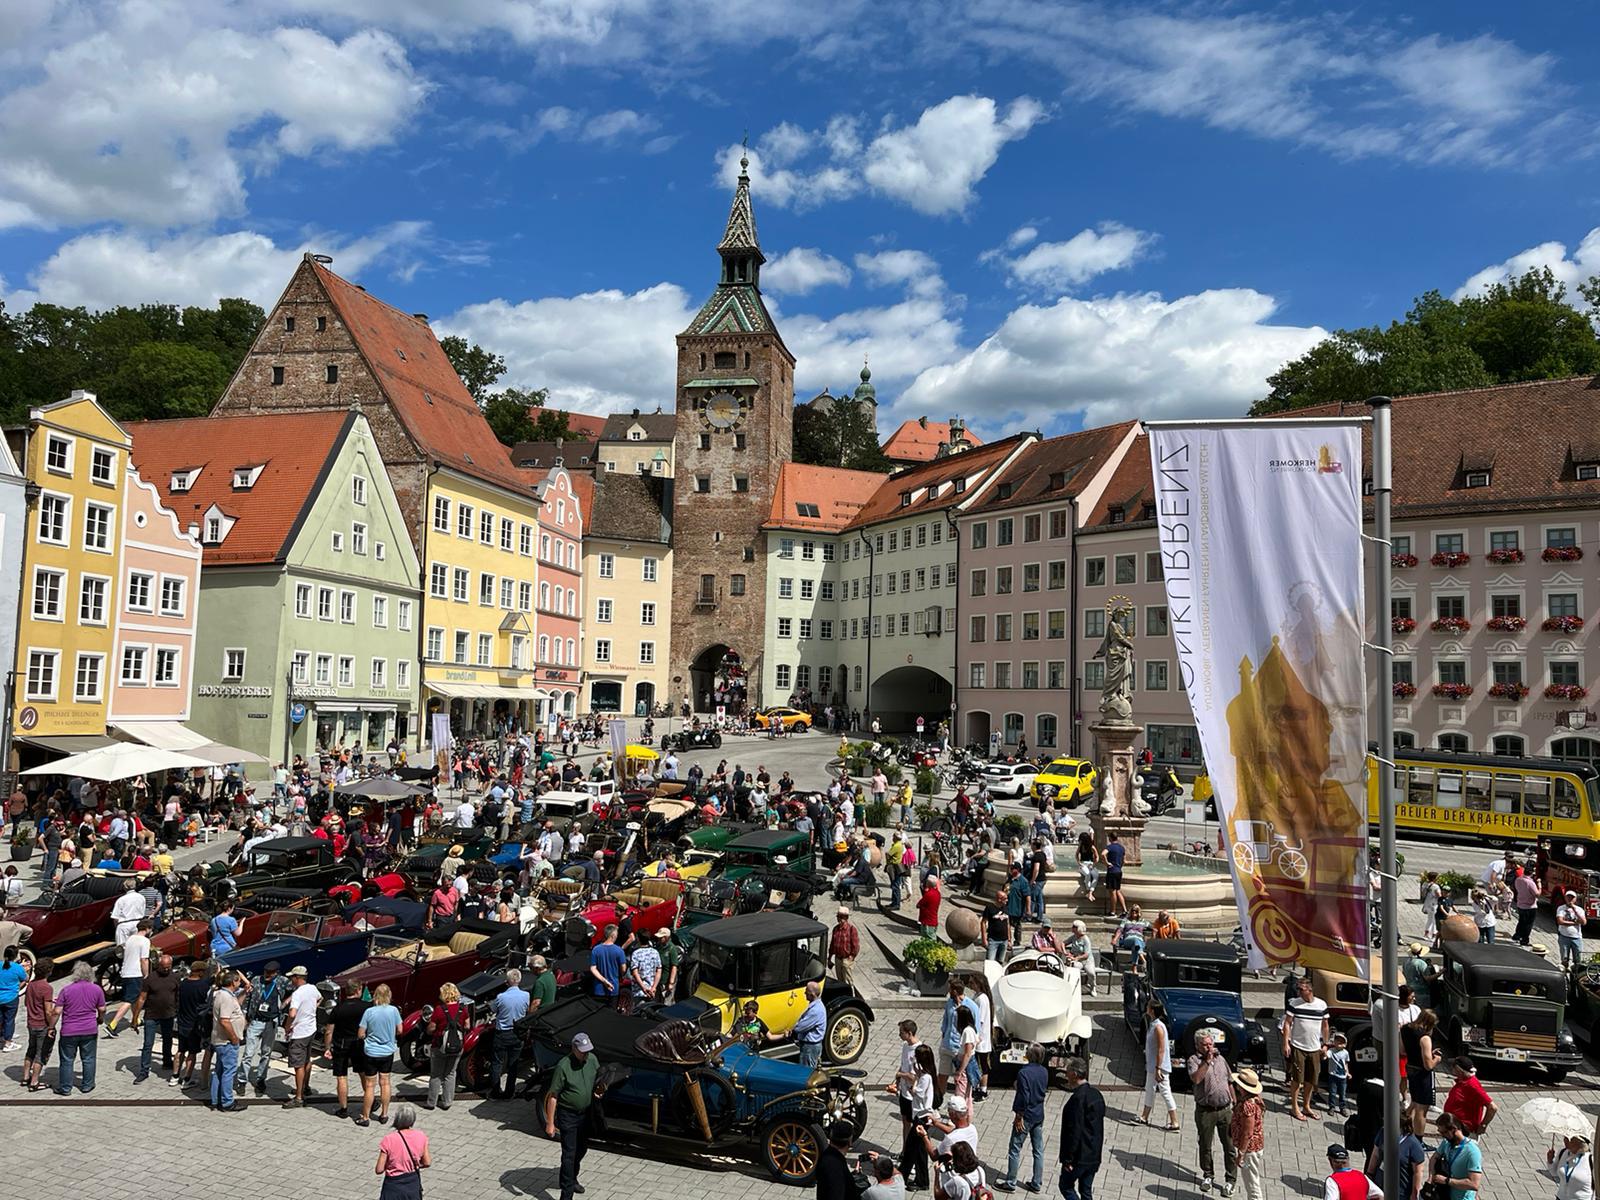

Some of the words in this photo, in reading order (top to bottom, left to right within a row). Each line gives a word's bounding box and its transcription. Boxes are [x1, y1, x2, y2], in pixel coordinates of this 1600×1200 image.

[199, 685, 272, 697] HOFPFISTEREI
[1444, 809, 1465, 822] DER
[1470, 813, 1553, 831] KRAFTFAHRER
